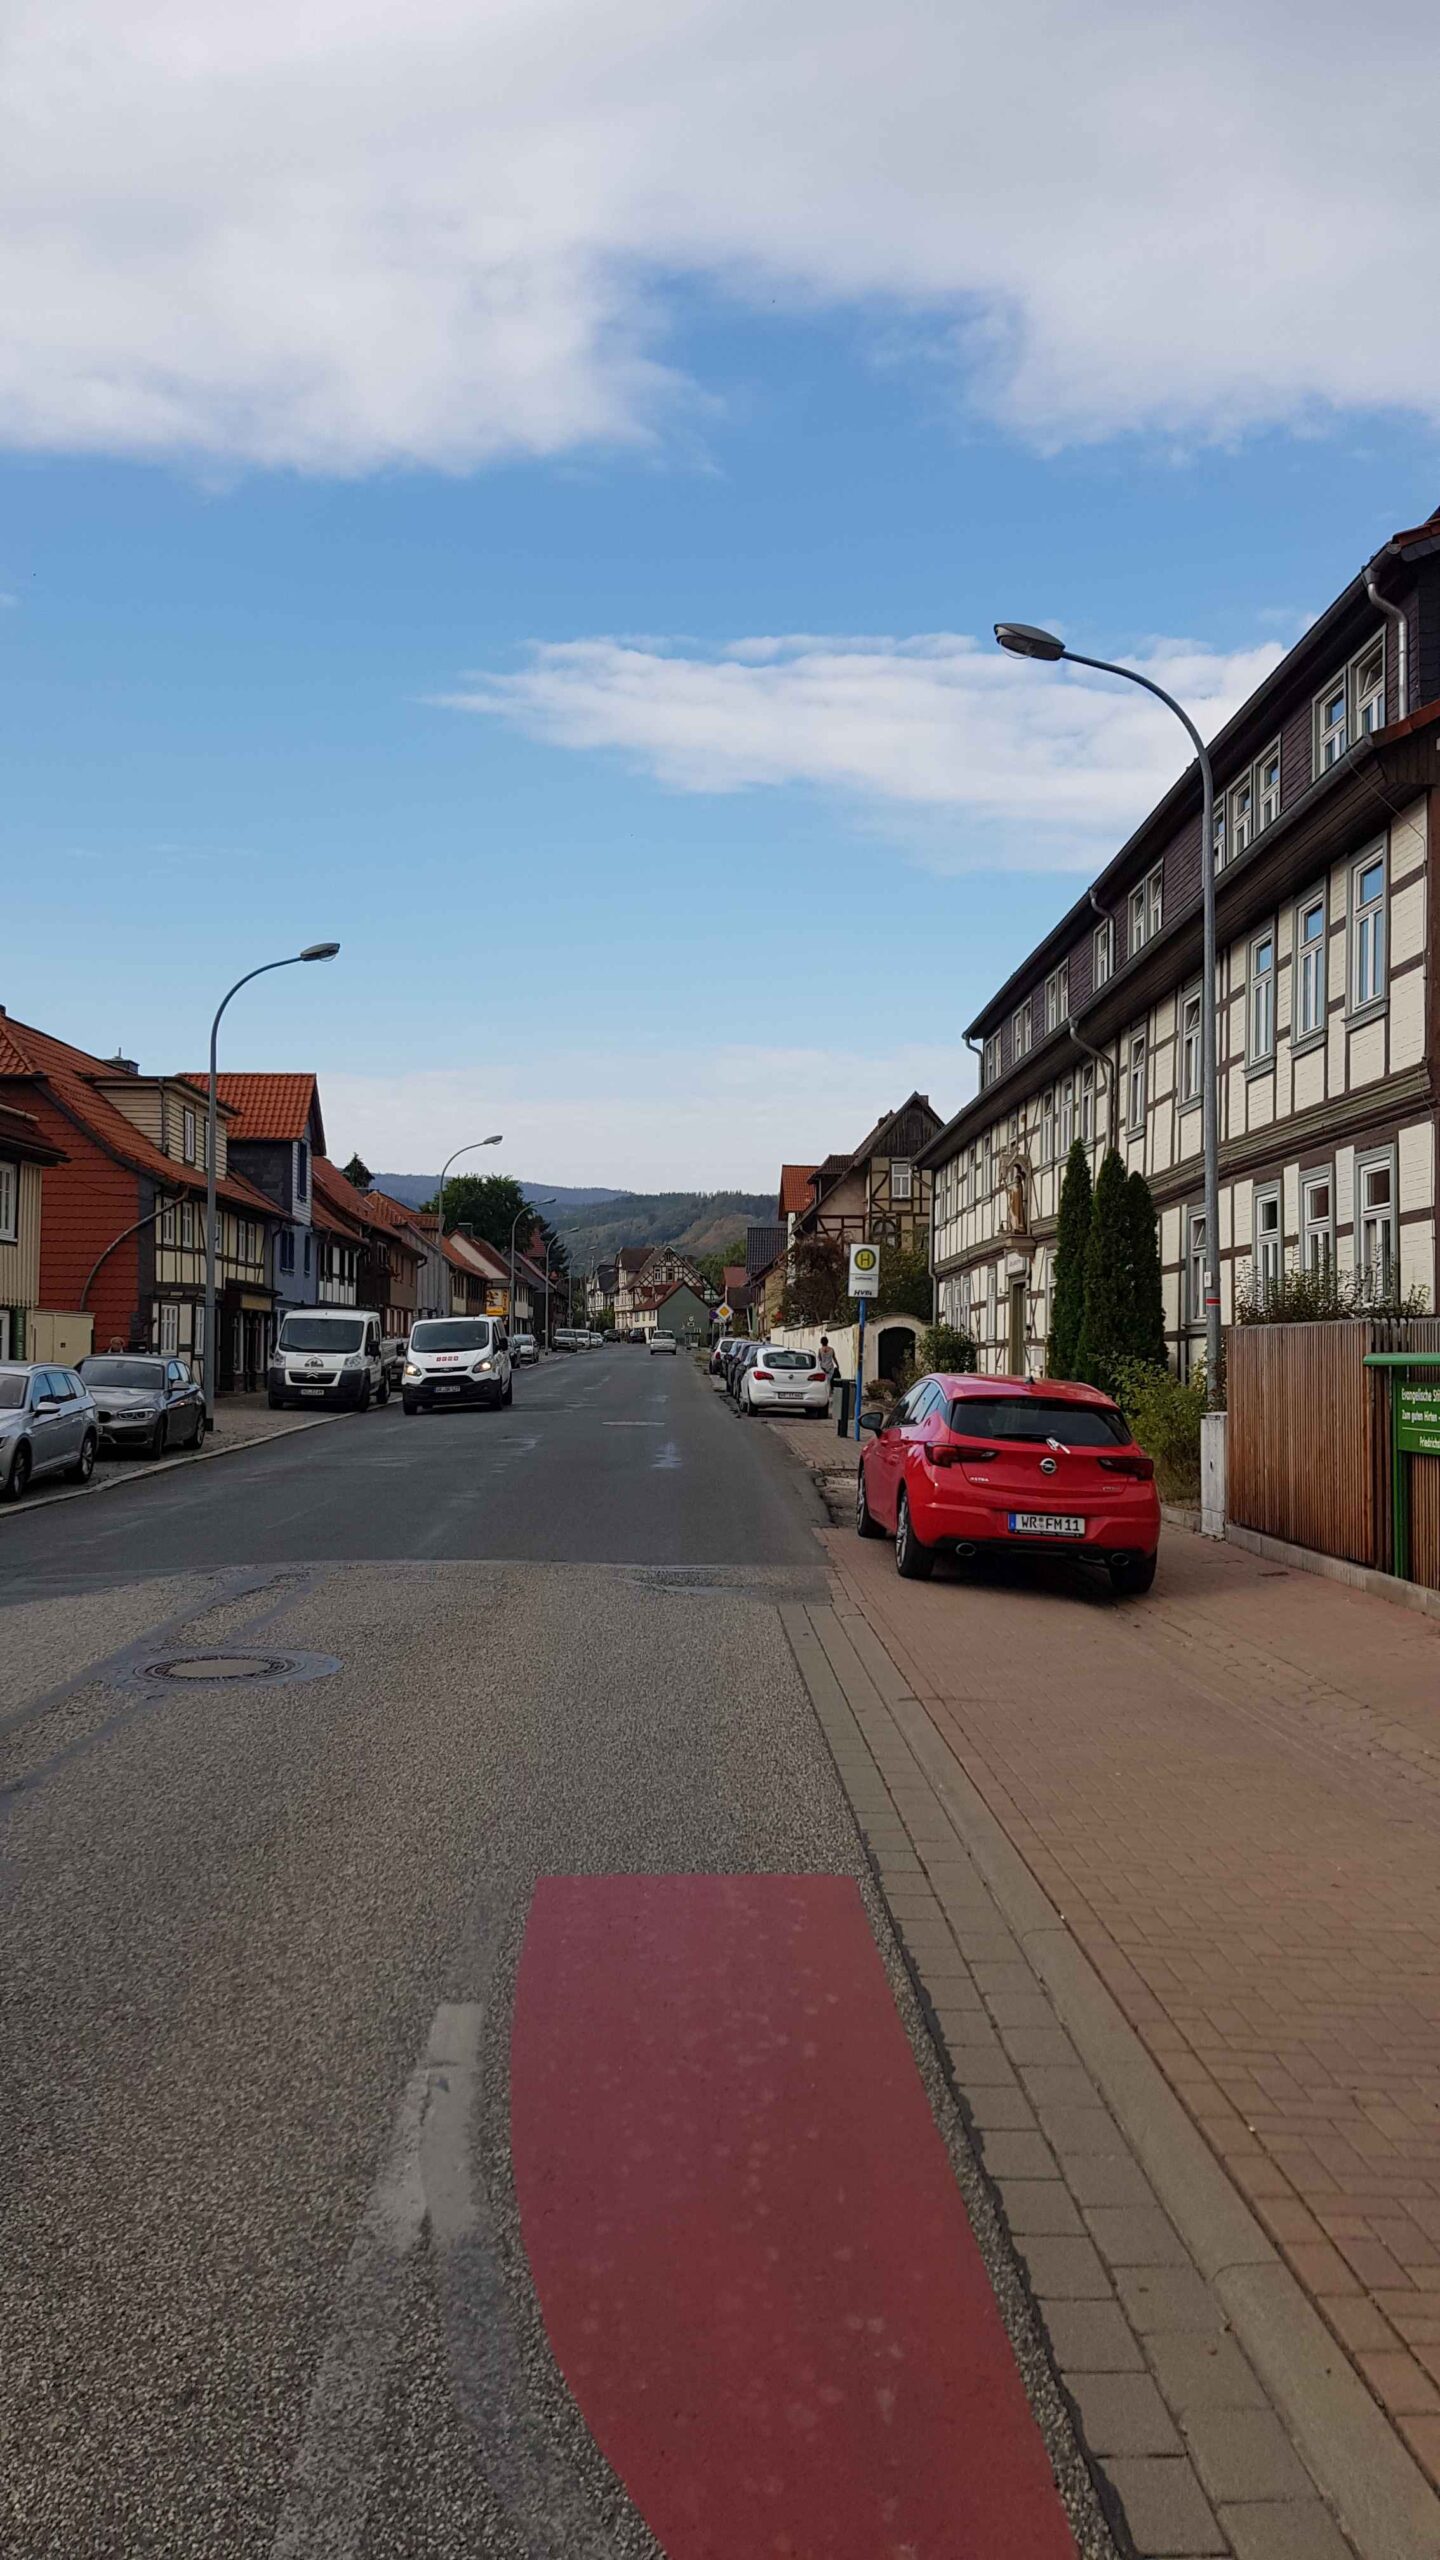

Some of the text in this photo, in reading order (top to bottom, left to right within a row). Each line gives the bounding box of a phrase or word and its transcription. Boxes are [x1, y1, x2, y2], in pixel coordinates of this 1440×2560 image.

[860, 1253, 871, 1266] H
[1402, 1387, 1432, 1404] Evangelische
[1402, 1409, 1437, 1424] Zum guten Hirten
